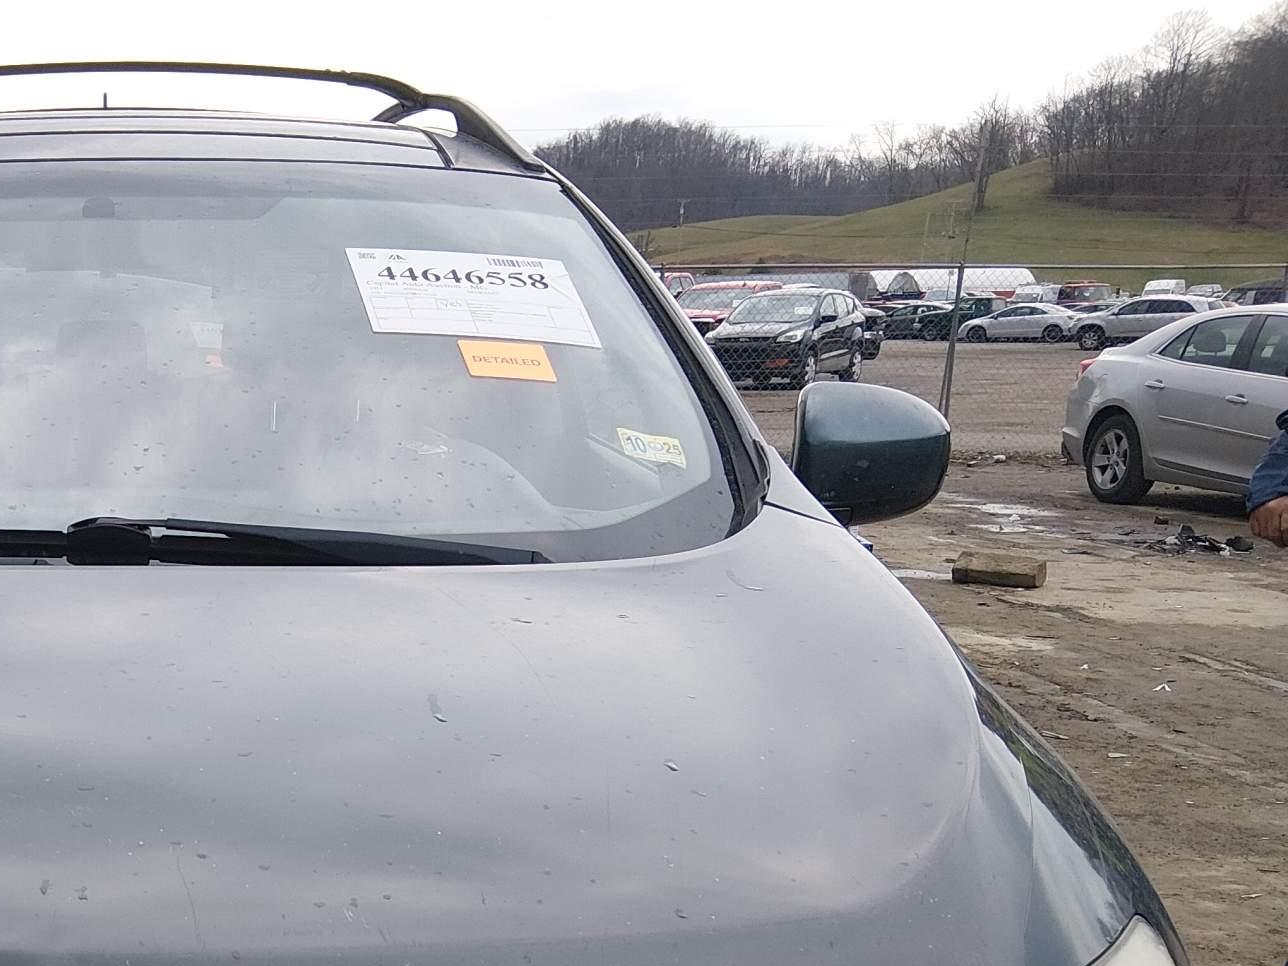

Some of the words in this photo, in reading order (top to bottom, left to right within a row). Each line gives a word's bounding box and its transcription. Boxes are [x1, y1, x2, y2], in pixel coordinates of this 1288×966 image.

[377, 265, 549, 290] 44646558
[472, 355, 541, 367] DETAILED
[626, 435, 647, 453] 10
[663, 441, 682, 456] 25
